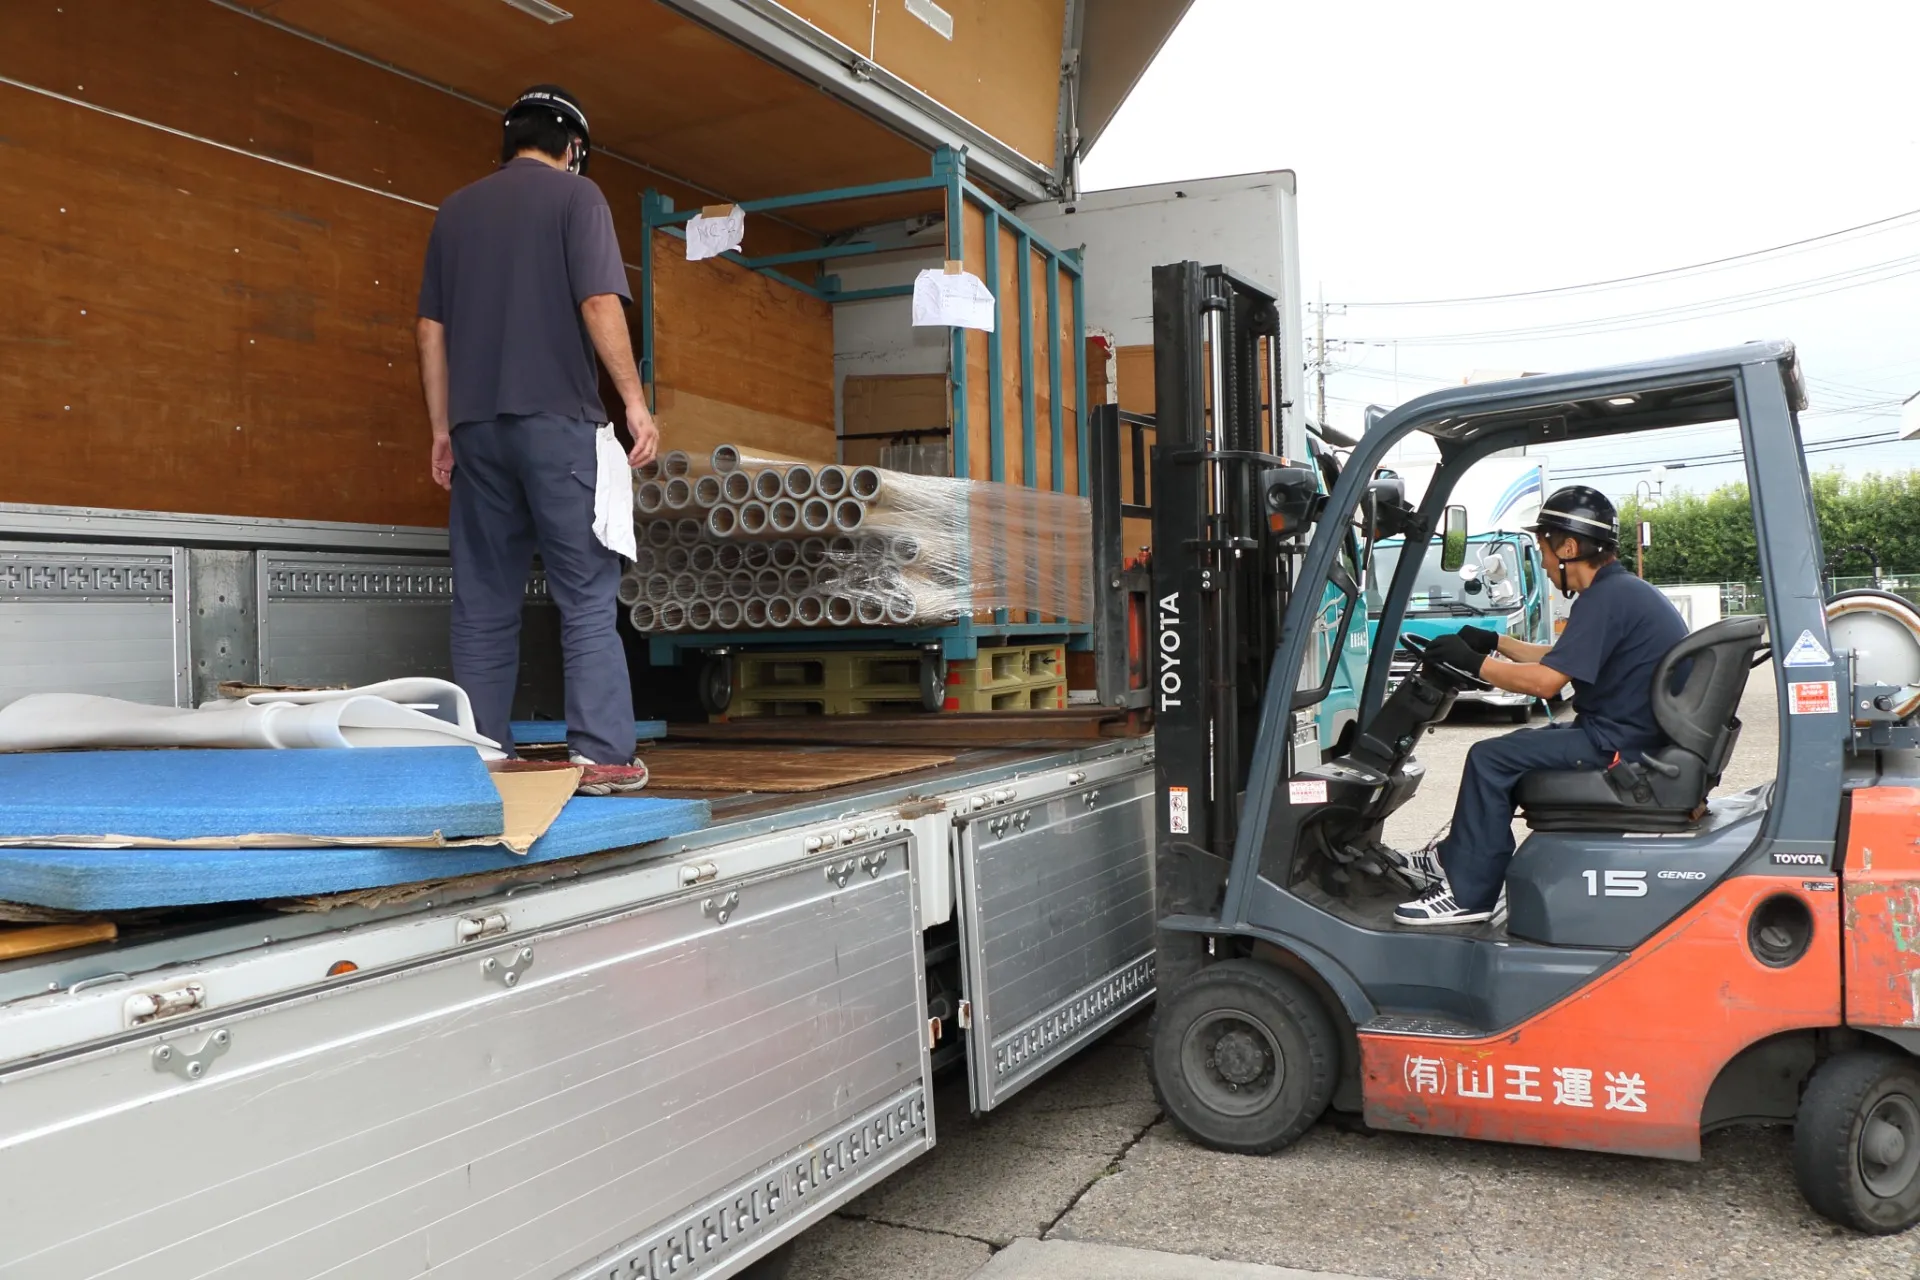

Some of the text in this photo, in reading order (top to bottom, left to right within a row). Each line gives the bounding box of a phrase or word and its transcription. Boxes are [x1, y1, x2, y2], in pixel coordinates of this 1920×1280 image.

[1159, 591, 1181, 712] TOYOTA
[1774, 854, 1824, 865] TOYOTA
[1582, 870, 1648, 897] 15
[1657, 870, 1706, 881] GENEO
